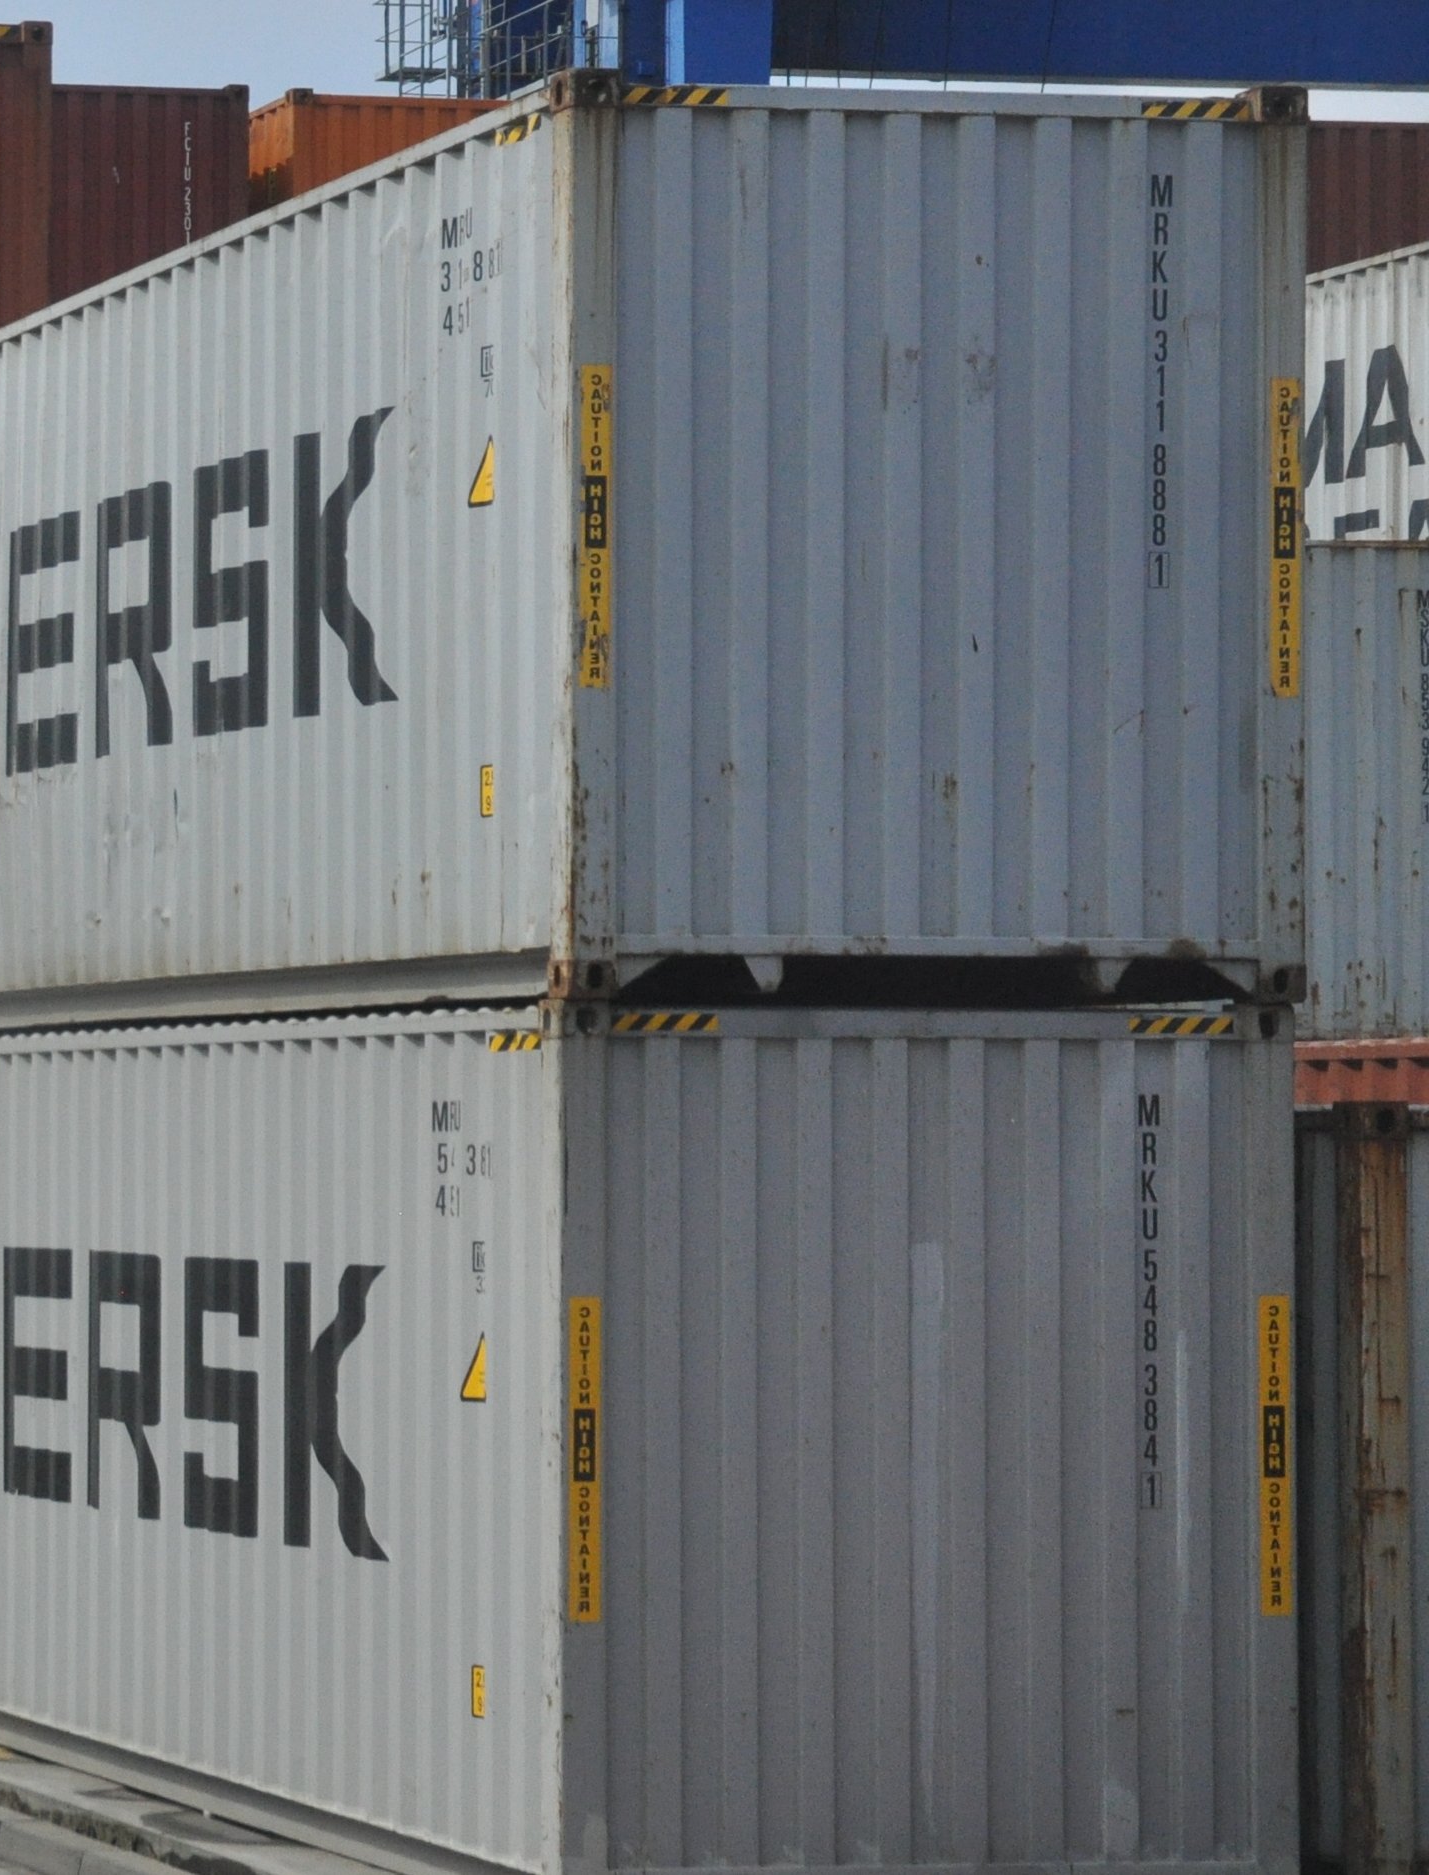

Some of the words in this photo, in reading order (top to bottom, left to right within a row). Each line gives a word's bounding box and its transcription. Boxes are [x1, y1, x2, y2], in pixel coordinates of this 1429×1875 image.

[1150, 174, 1173, 322] MRKU
[1152, 330, 1166, 432] 311
[1151, 444, 1166, 546] 888
[1137, 1094, 1161, 1240] MRKU
[1142, 1249, 1158, 1352] 548
[1142, 1363, 1158, 1466] 384
